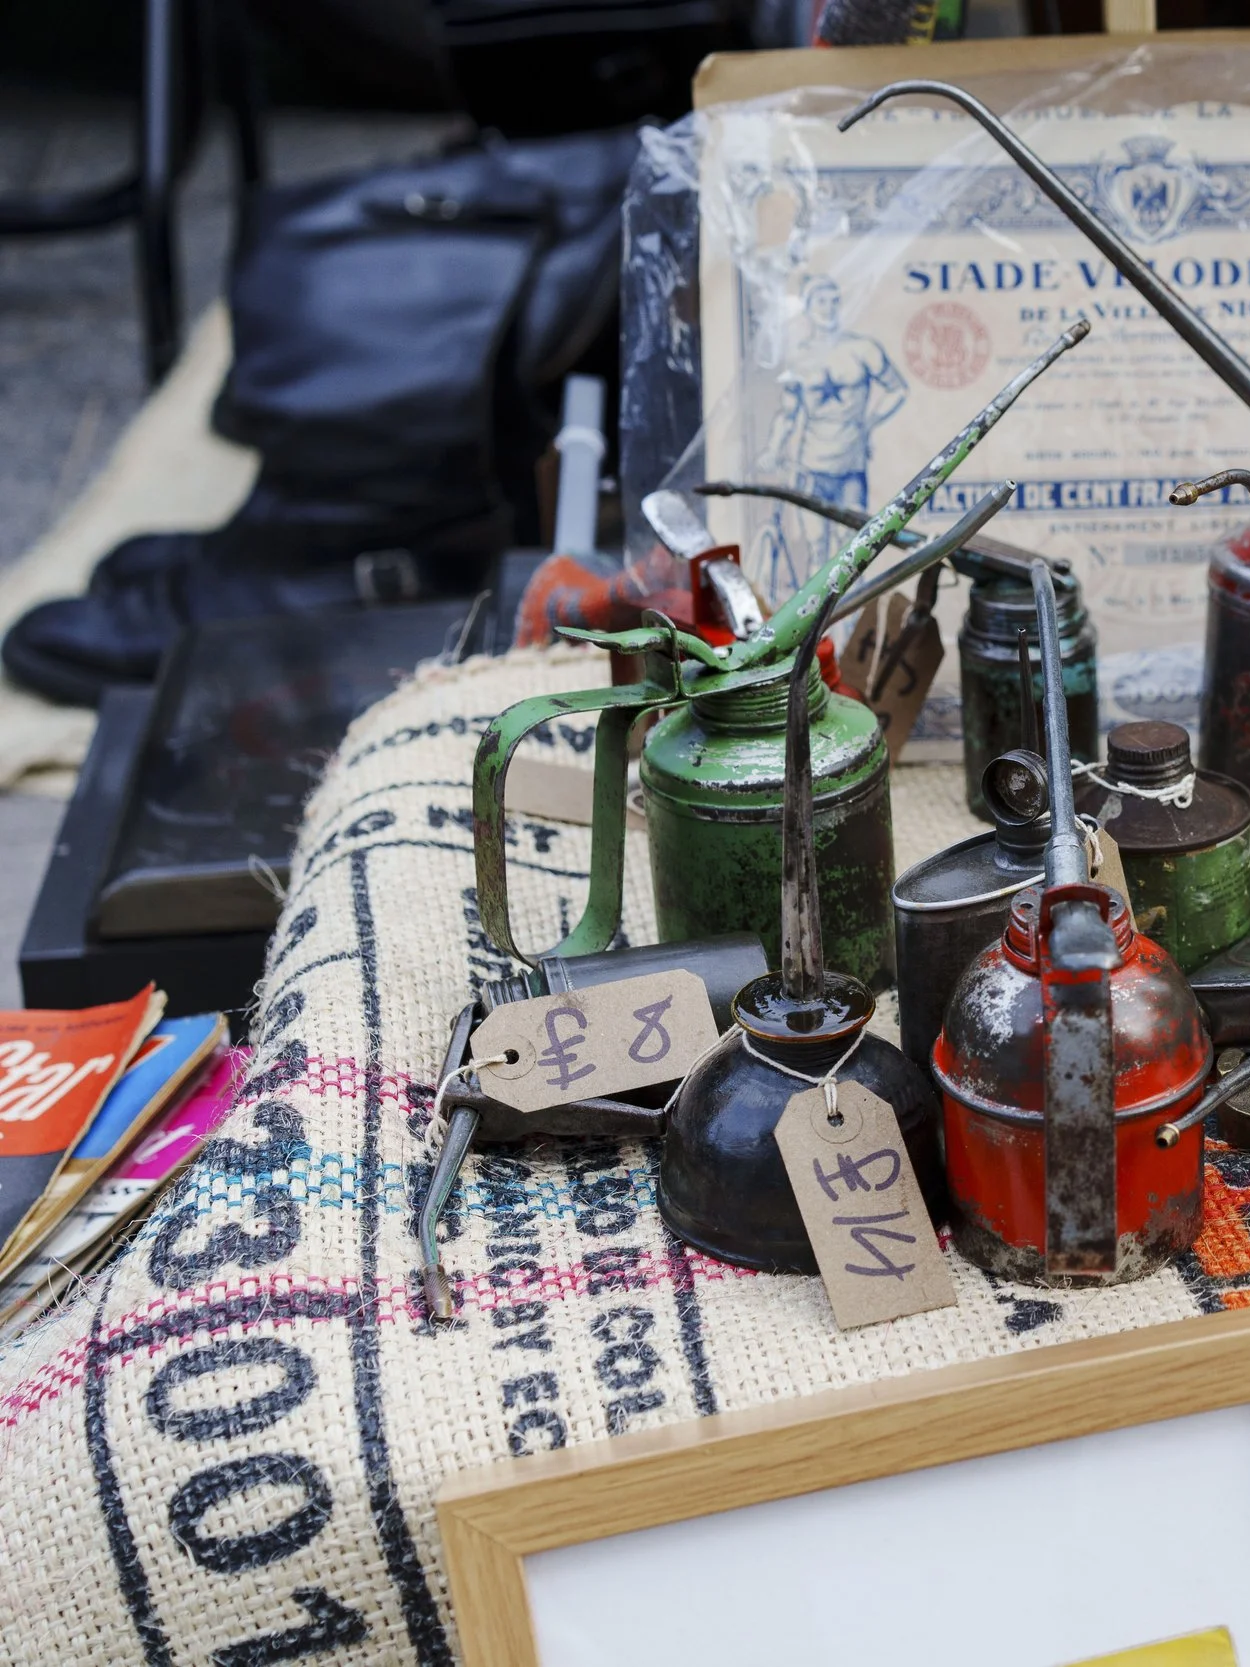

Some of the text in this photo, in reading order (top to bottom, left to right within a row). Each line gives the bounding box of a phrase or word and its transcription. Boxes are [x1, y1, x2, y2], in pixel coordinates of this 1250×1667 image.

[903, 260, 1061, 294] STADE
[1024, 483, 1056, 509] DE
[1060, 481, 1119, 508] CENT
[537, 994, 673, 1090] £ 8
